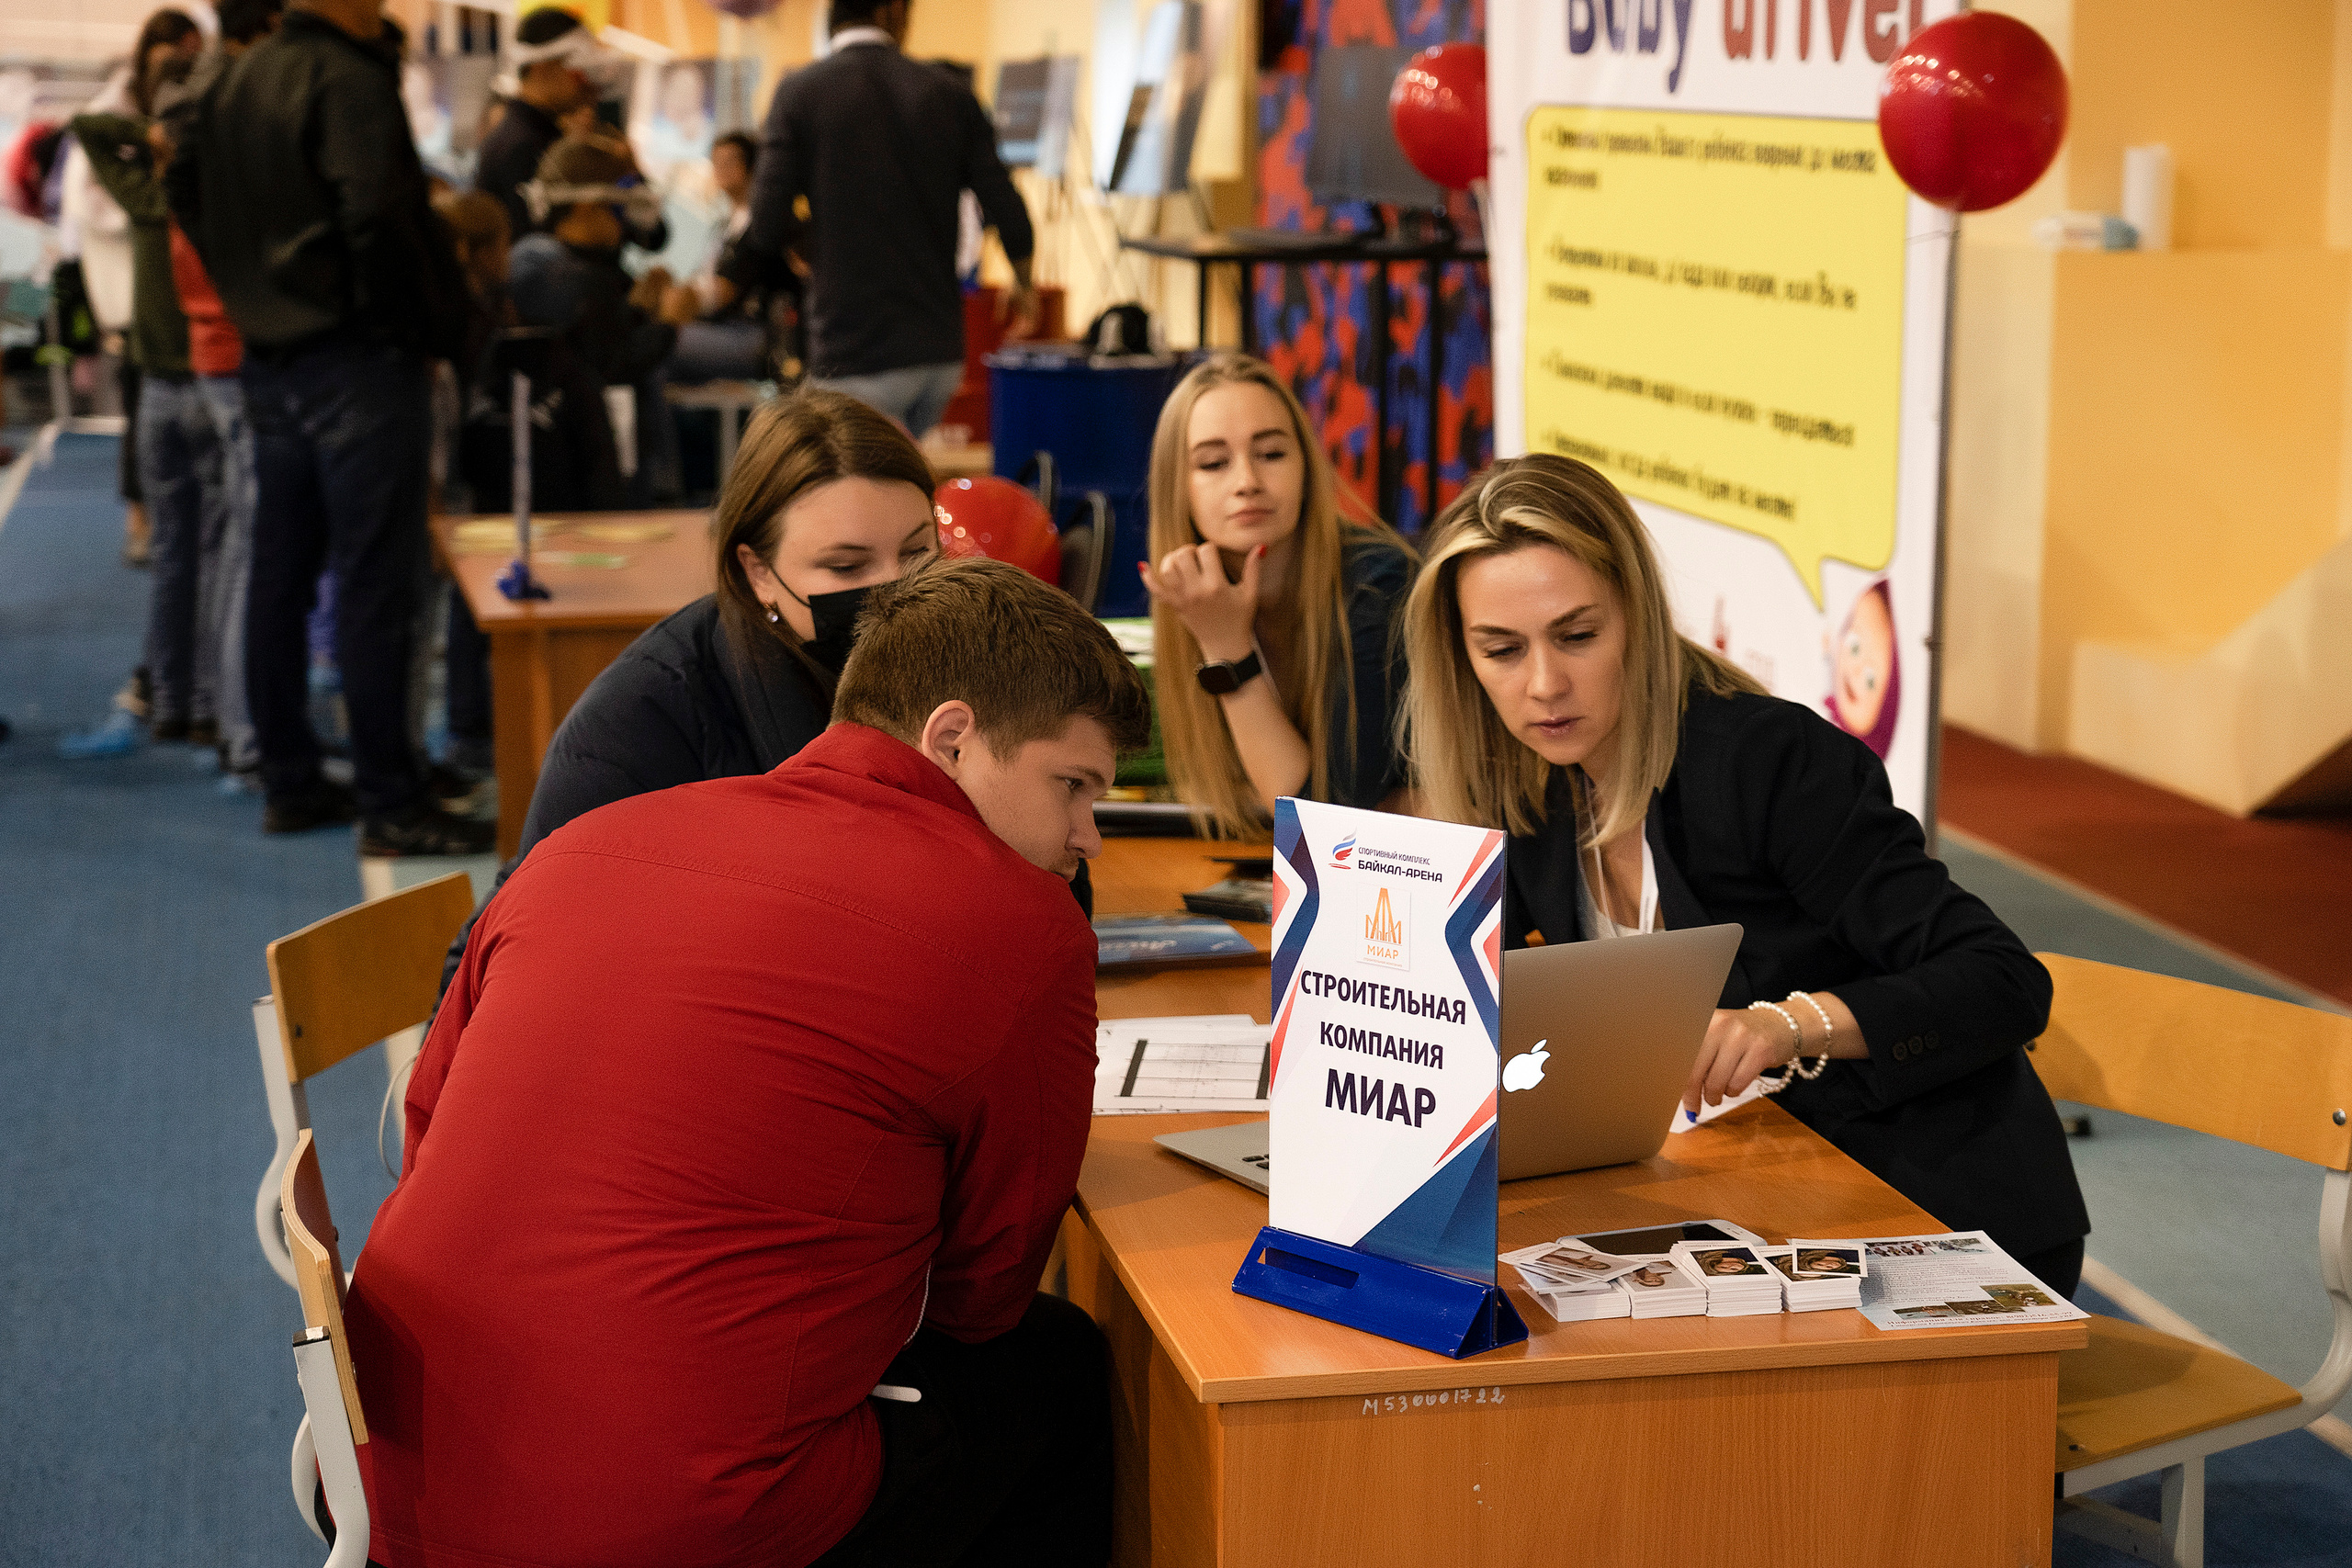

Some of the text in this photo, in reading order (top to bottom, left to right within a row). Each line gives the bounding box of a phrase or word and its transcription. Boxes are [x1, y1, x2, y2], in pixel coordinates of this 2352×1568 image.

[1358, 846, 1430, 866] СПОРТИВНЫЙ КОМПЛЕКС
[1358, 859, 1442, 883] БАЙКАЛ-АРЕНА
[1366, 944, 1399, 960] МИАР
[1301, 970, 1466, 1025] СТРОИТЕЛЬНАЯ
[1320, 1021, 1443, 1069] КОМПАНИЯ
[1325, 1068, 1436, 1129] МИАР
